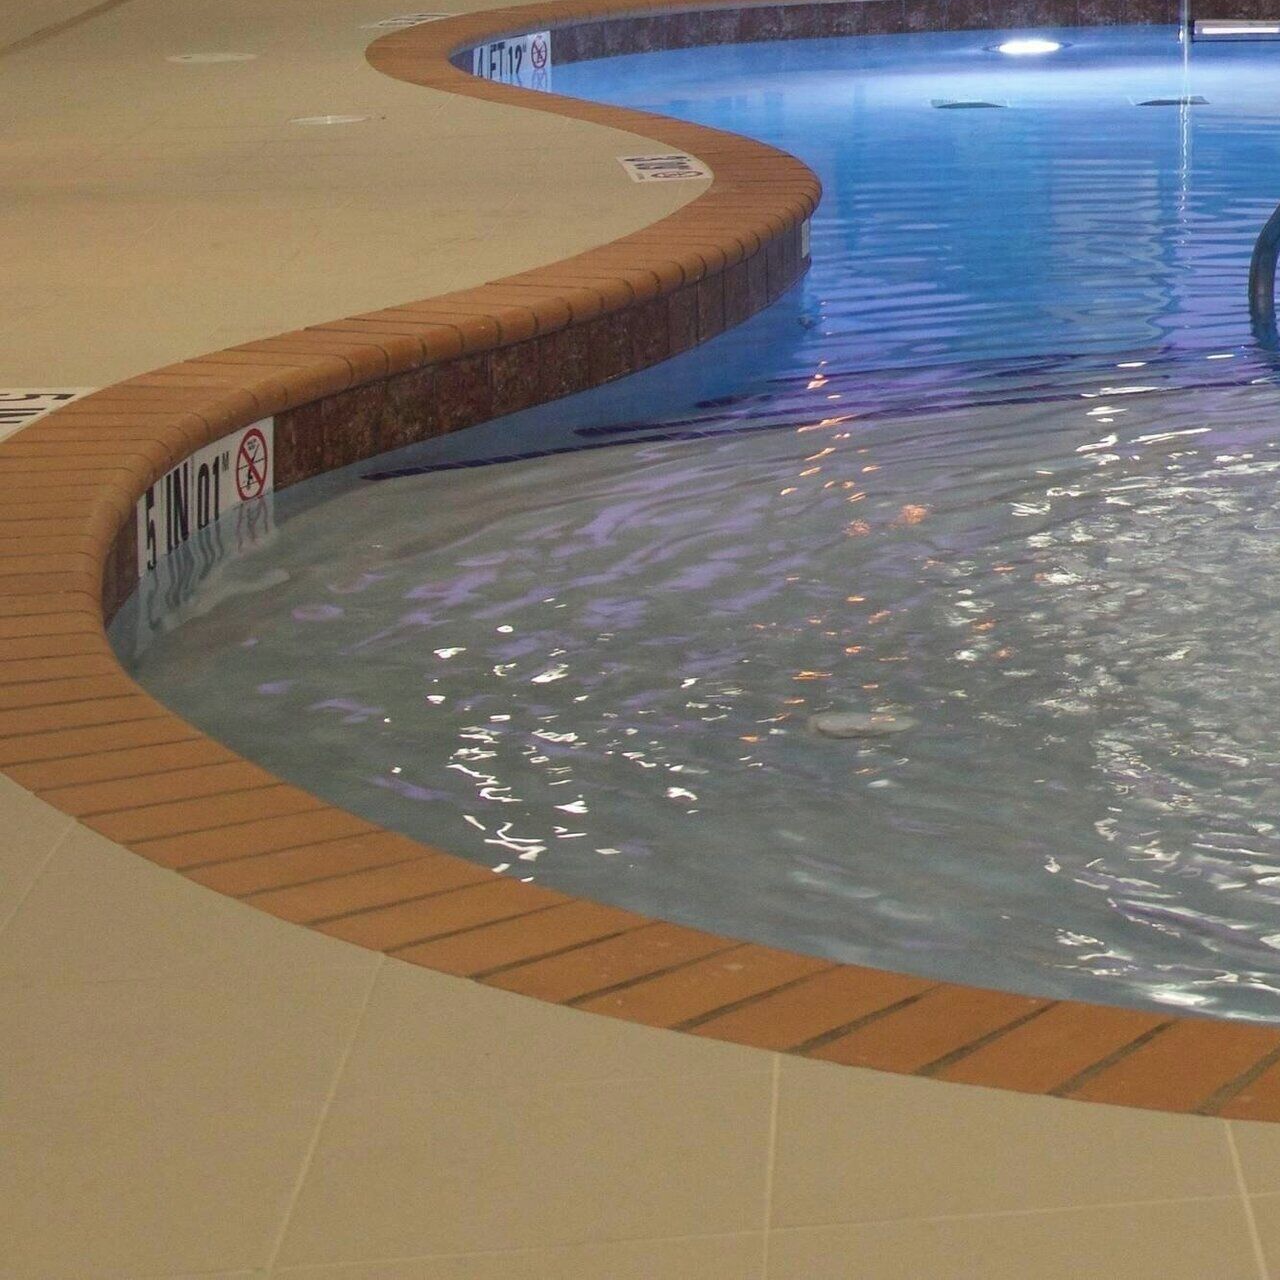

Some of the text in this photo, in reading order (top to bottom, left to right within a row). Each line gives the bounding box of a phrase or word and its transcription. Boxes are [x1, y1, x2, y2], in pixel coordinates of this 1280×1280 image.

[490, 41, 505, 79] FT
[145, 484, 157, 570] 5
[166, 462, 189, 556] IN
